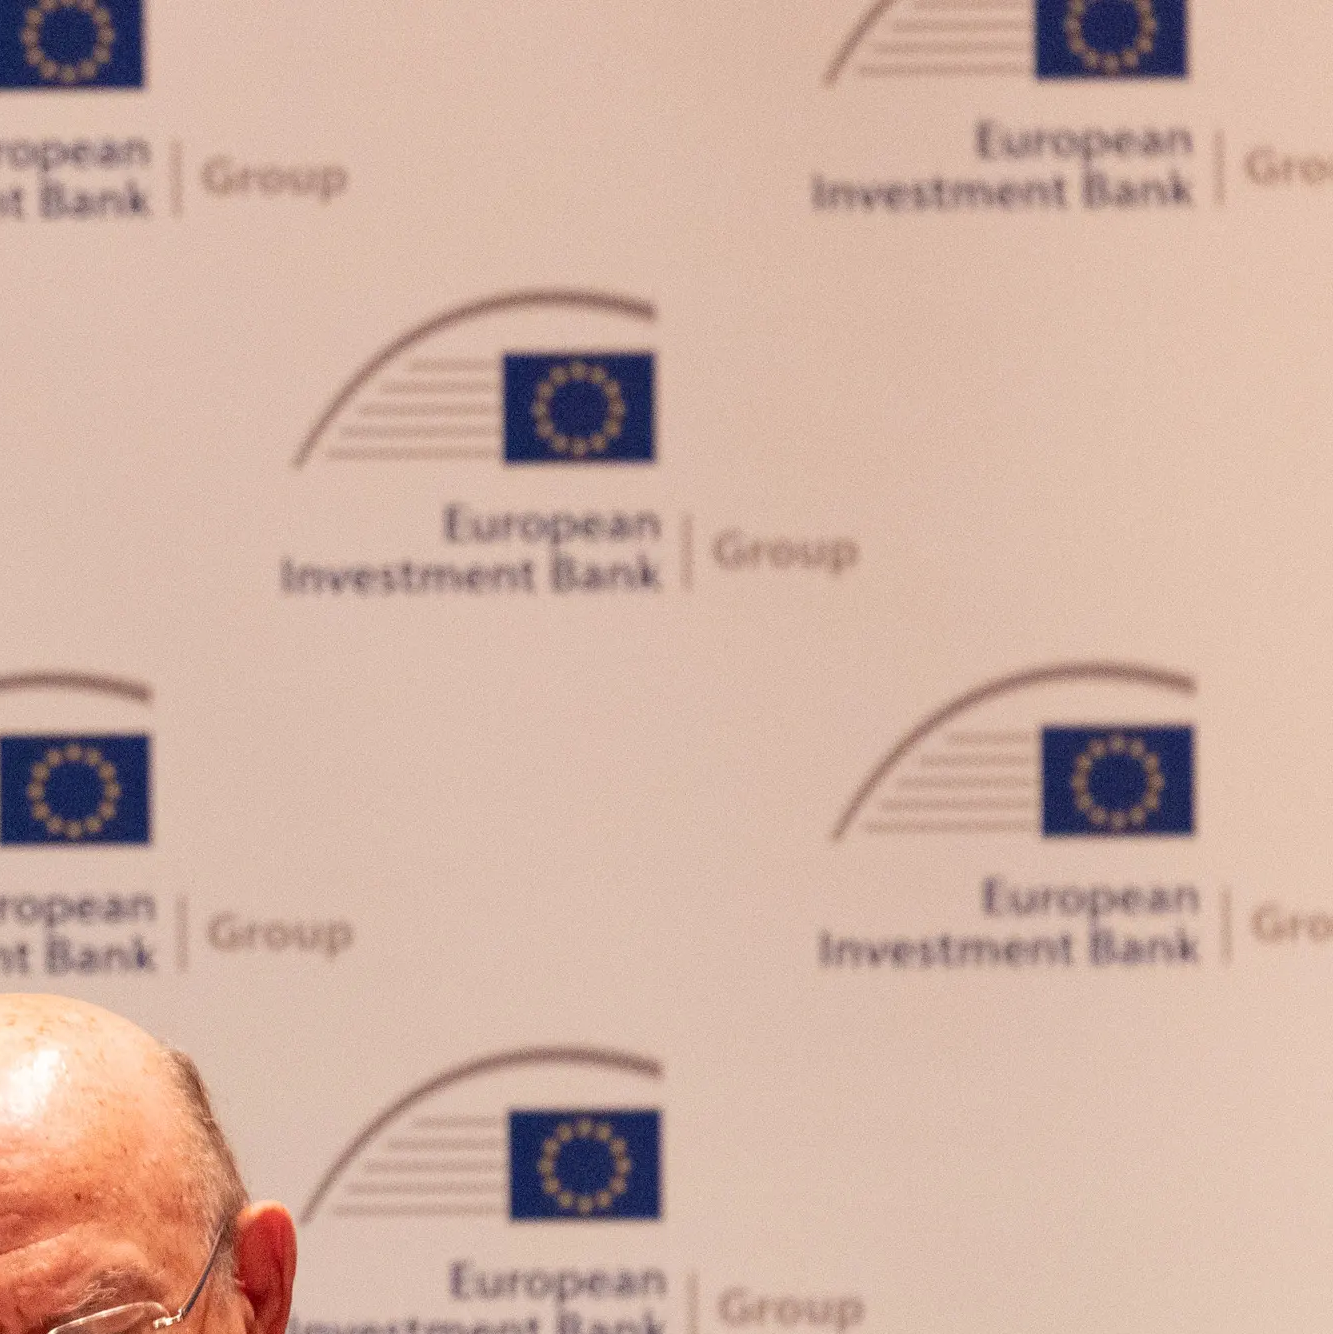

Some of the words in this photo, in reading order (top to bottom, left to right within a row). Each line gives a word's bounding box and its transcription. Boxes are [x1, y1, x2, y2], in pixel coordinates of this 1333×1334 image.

[973, 118, 1193, 170] European
[1242, 145, 1333, 187] Gro
[38, 179, 150, 220] Bank
[199, 155, 350, 205] Group
[811, 175, 1067, 213] Investment
[1080, 169, 1192, 210] Bank
[442, 502, 662, 552] European
[280, 558, 536, 596] Investment
[549, 553, 661, 594] Bank
[710, 528, 860, 578] Group
[980, 875, 1200, 924] European
[44, 935, 155, 976] Bank
[205, 911, 355, 961] Group
[818, 931, 1074, 969] Investment
[1087, 926, 1198, 967] Bank
[448, 1260, 667, 1312] European
